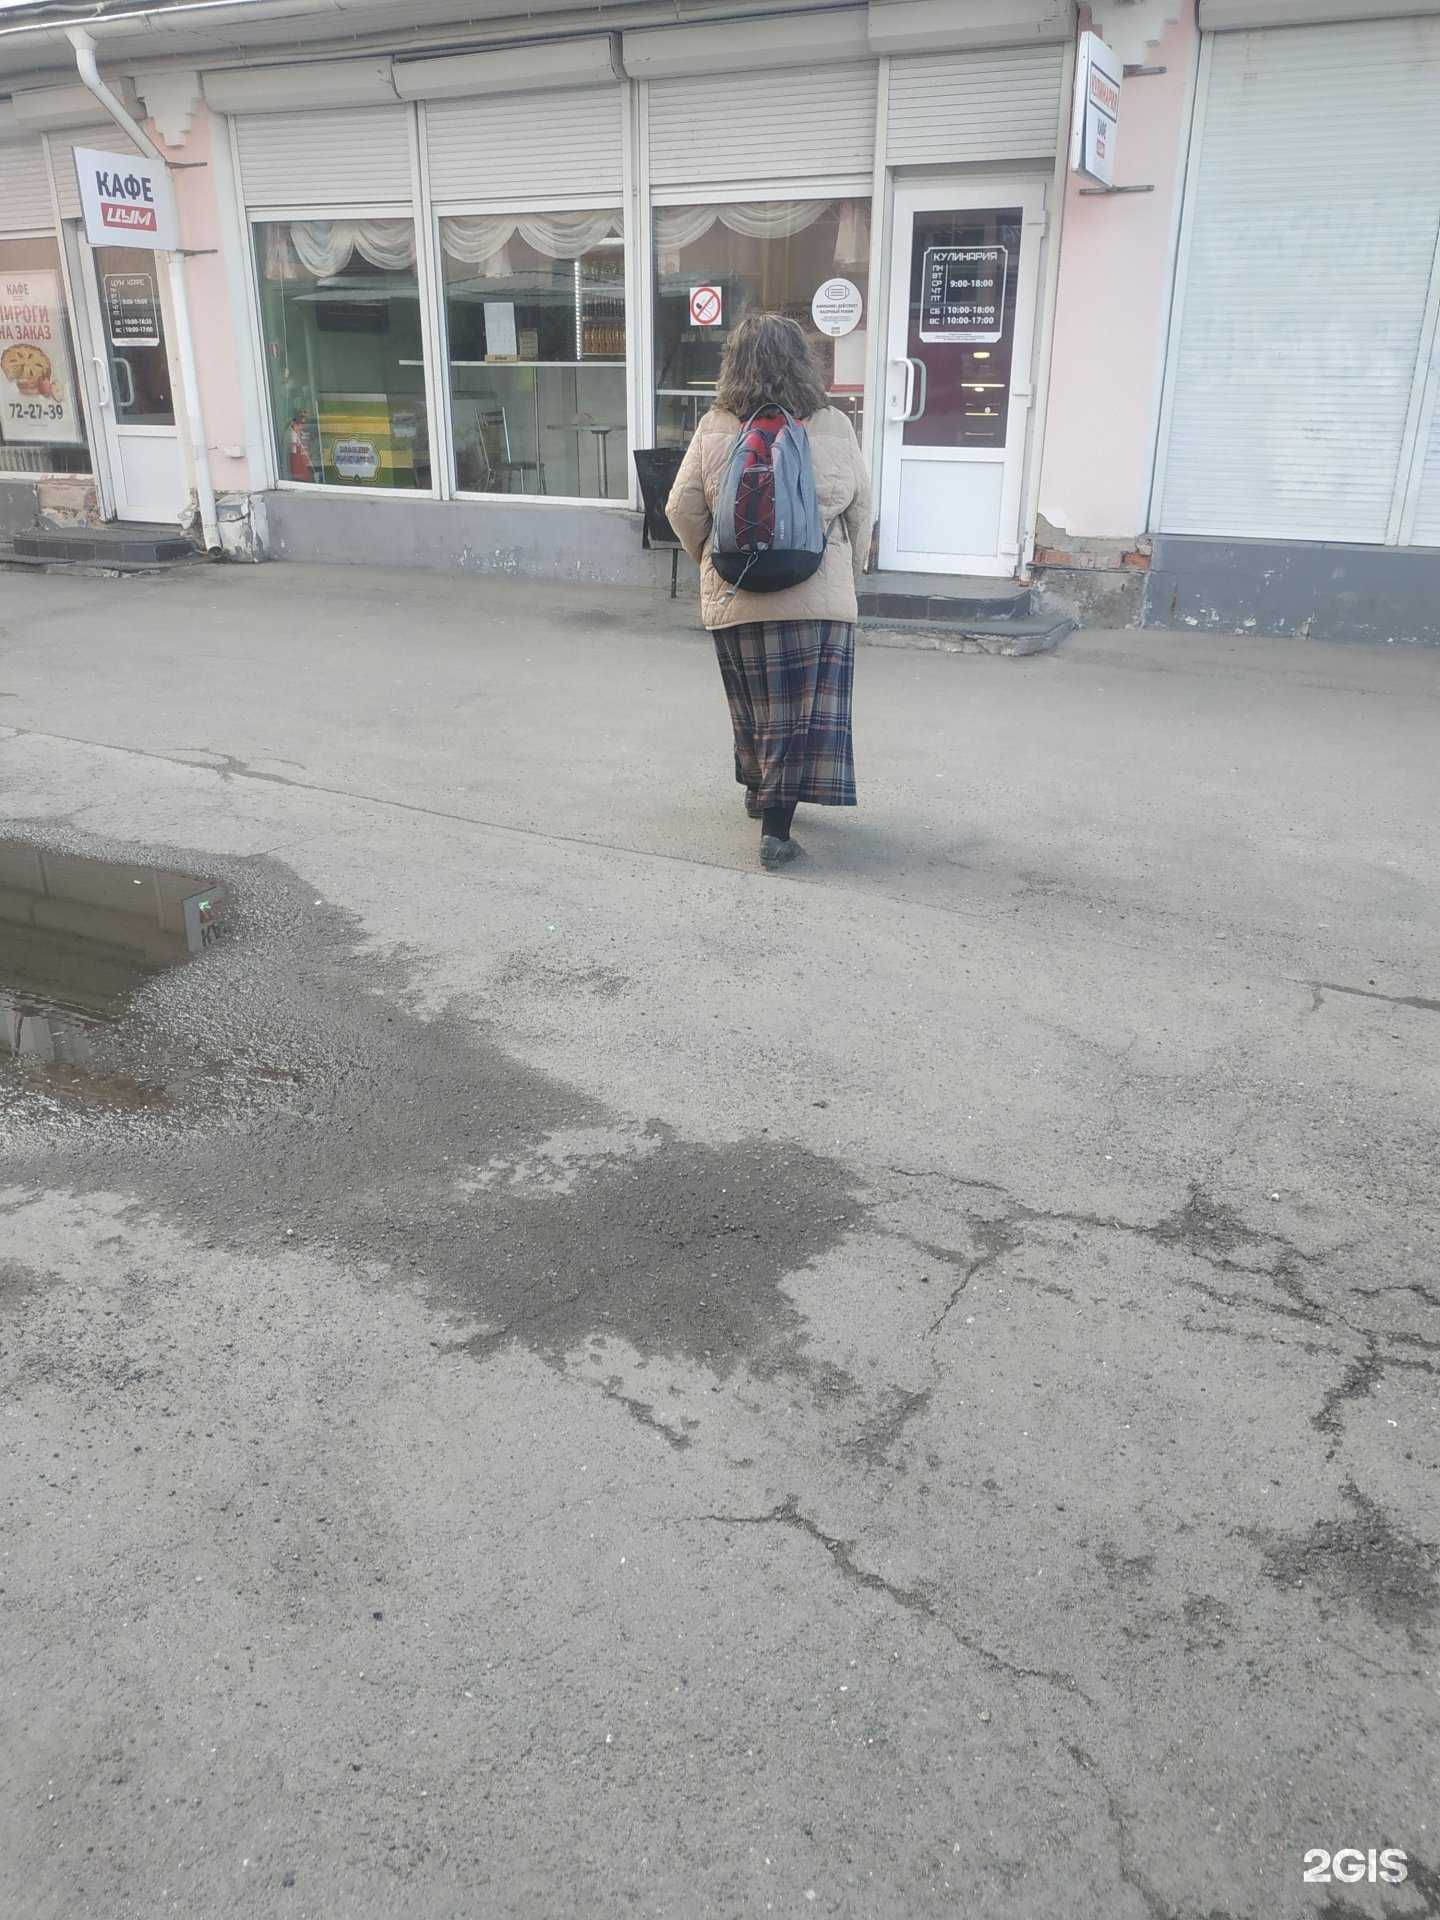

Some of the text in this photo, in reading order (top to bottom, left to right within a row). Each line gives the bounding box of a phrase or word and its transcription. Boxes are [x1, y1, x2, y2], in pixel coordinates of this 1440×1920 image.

[95, 170, 154, 202] КАФЕ
[933, 252, 998, 261] КУЛИНАРИЯ
[6, 283, 30, 296] КАФЕ
[947, 306, 995, 314] 10:00-18:00
[946, 316, 995, 325] 10:00-17:00
[15, 325, 52, 340] ЗАКАЗ
[9, 402, 64, 420] 72-27-39
